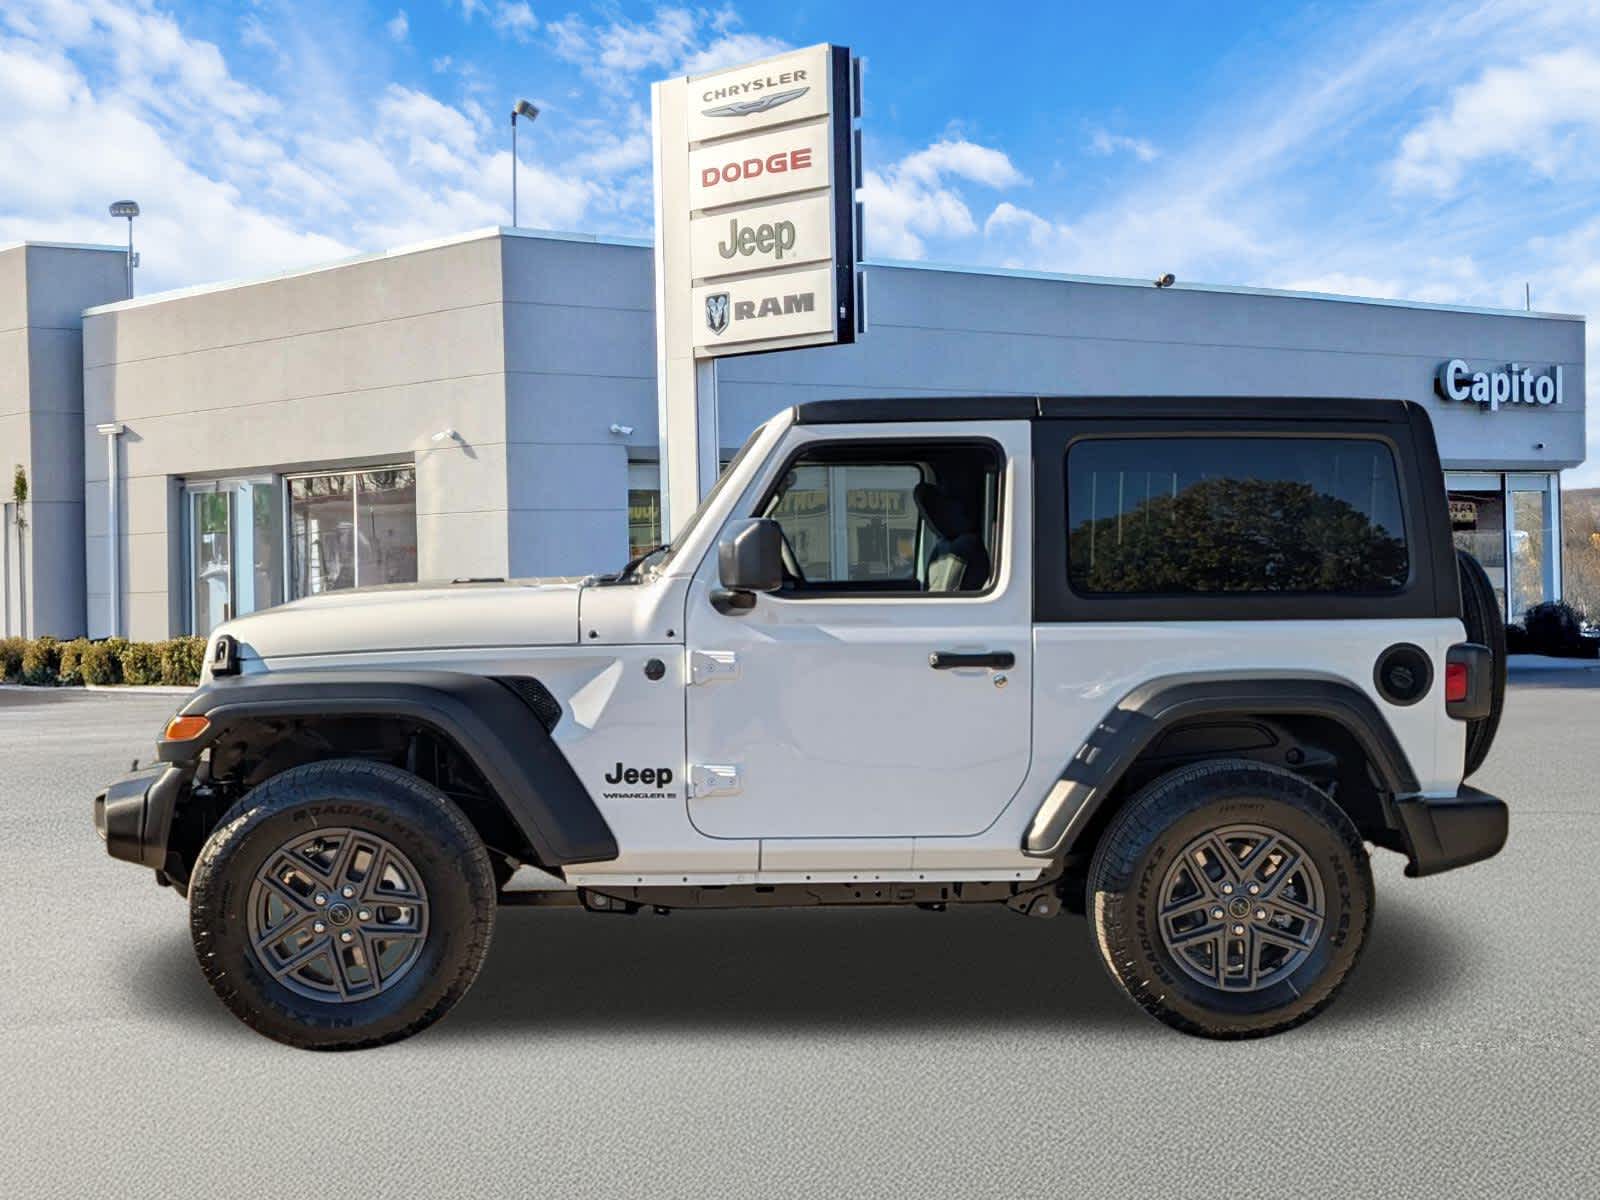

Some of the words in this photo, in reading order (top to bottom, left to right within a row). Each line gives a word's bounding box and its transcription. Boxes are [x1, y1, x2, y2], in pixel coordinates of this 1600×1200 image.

[702, 69, 807, 102] CHRYSLER
[702, 148, 812, 187] DODGE
[718, 218, 796, 260] Jeep
[734, 292, 815, 321] RAM
[1446, 358, 1564, 412] Capitol
[604, 761, 673, 789] Jeep
[602, 792, 665, 800] WRANGLER
